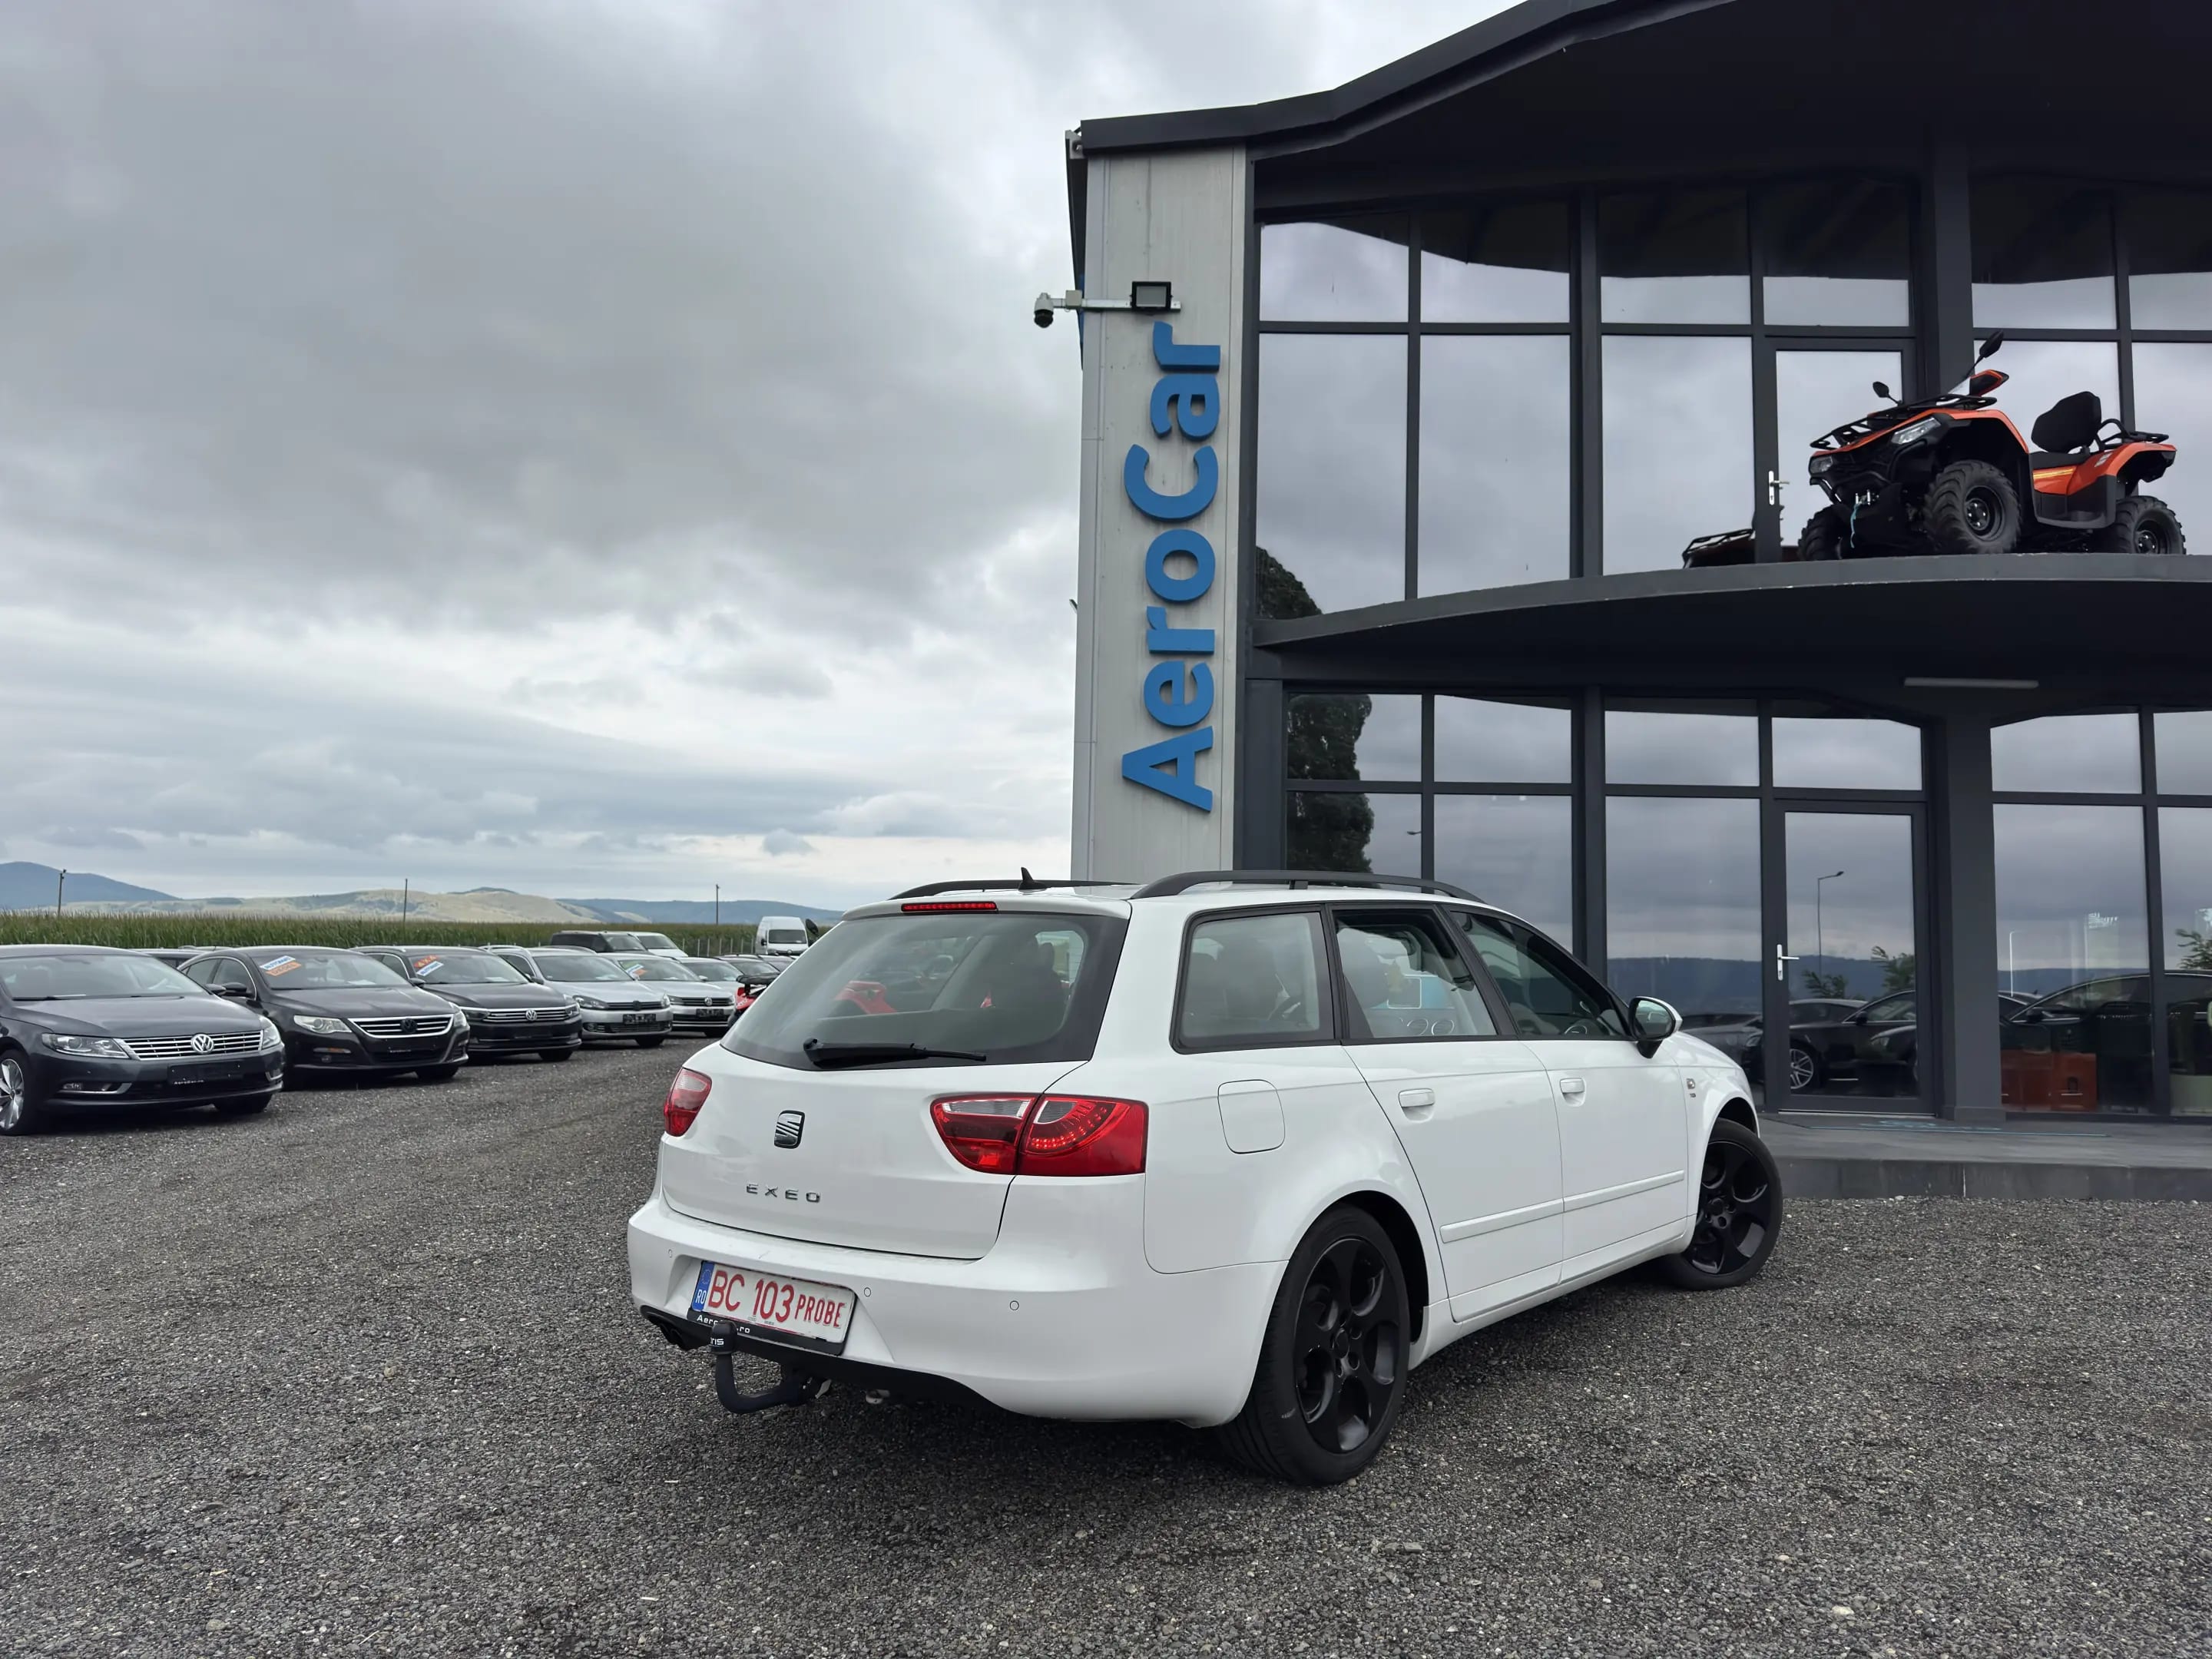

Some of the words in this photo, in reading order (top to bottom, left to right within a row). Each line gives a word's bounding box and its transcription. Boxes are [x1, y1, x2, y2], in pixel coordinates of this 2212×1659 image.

[1122, 321, 1220, 813] AeroCar
[746, 1183, 821, 1203] EXEO
[695, 1289, 707, 1305] RO
[708, 1270, 745, 1312] BC
[753, 1278, 795, 1323] 103
[794, 1294, 845, 1328] PROBE
